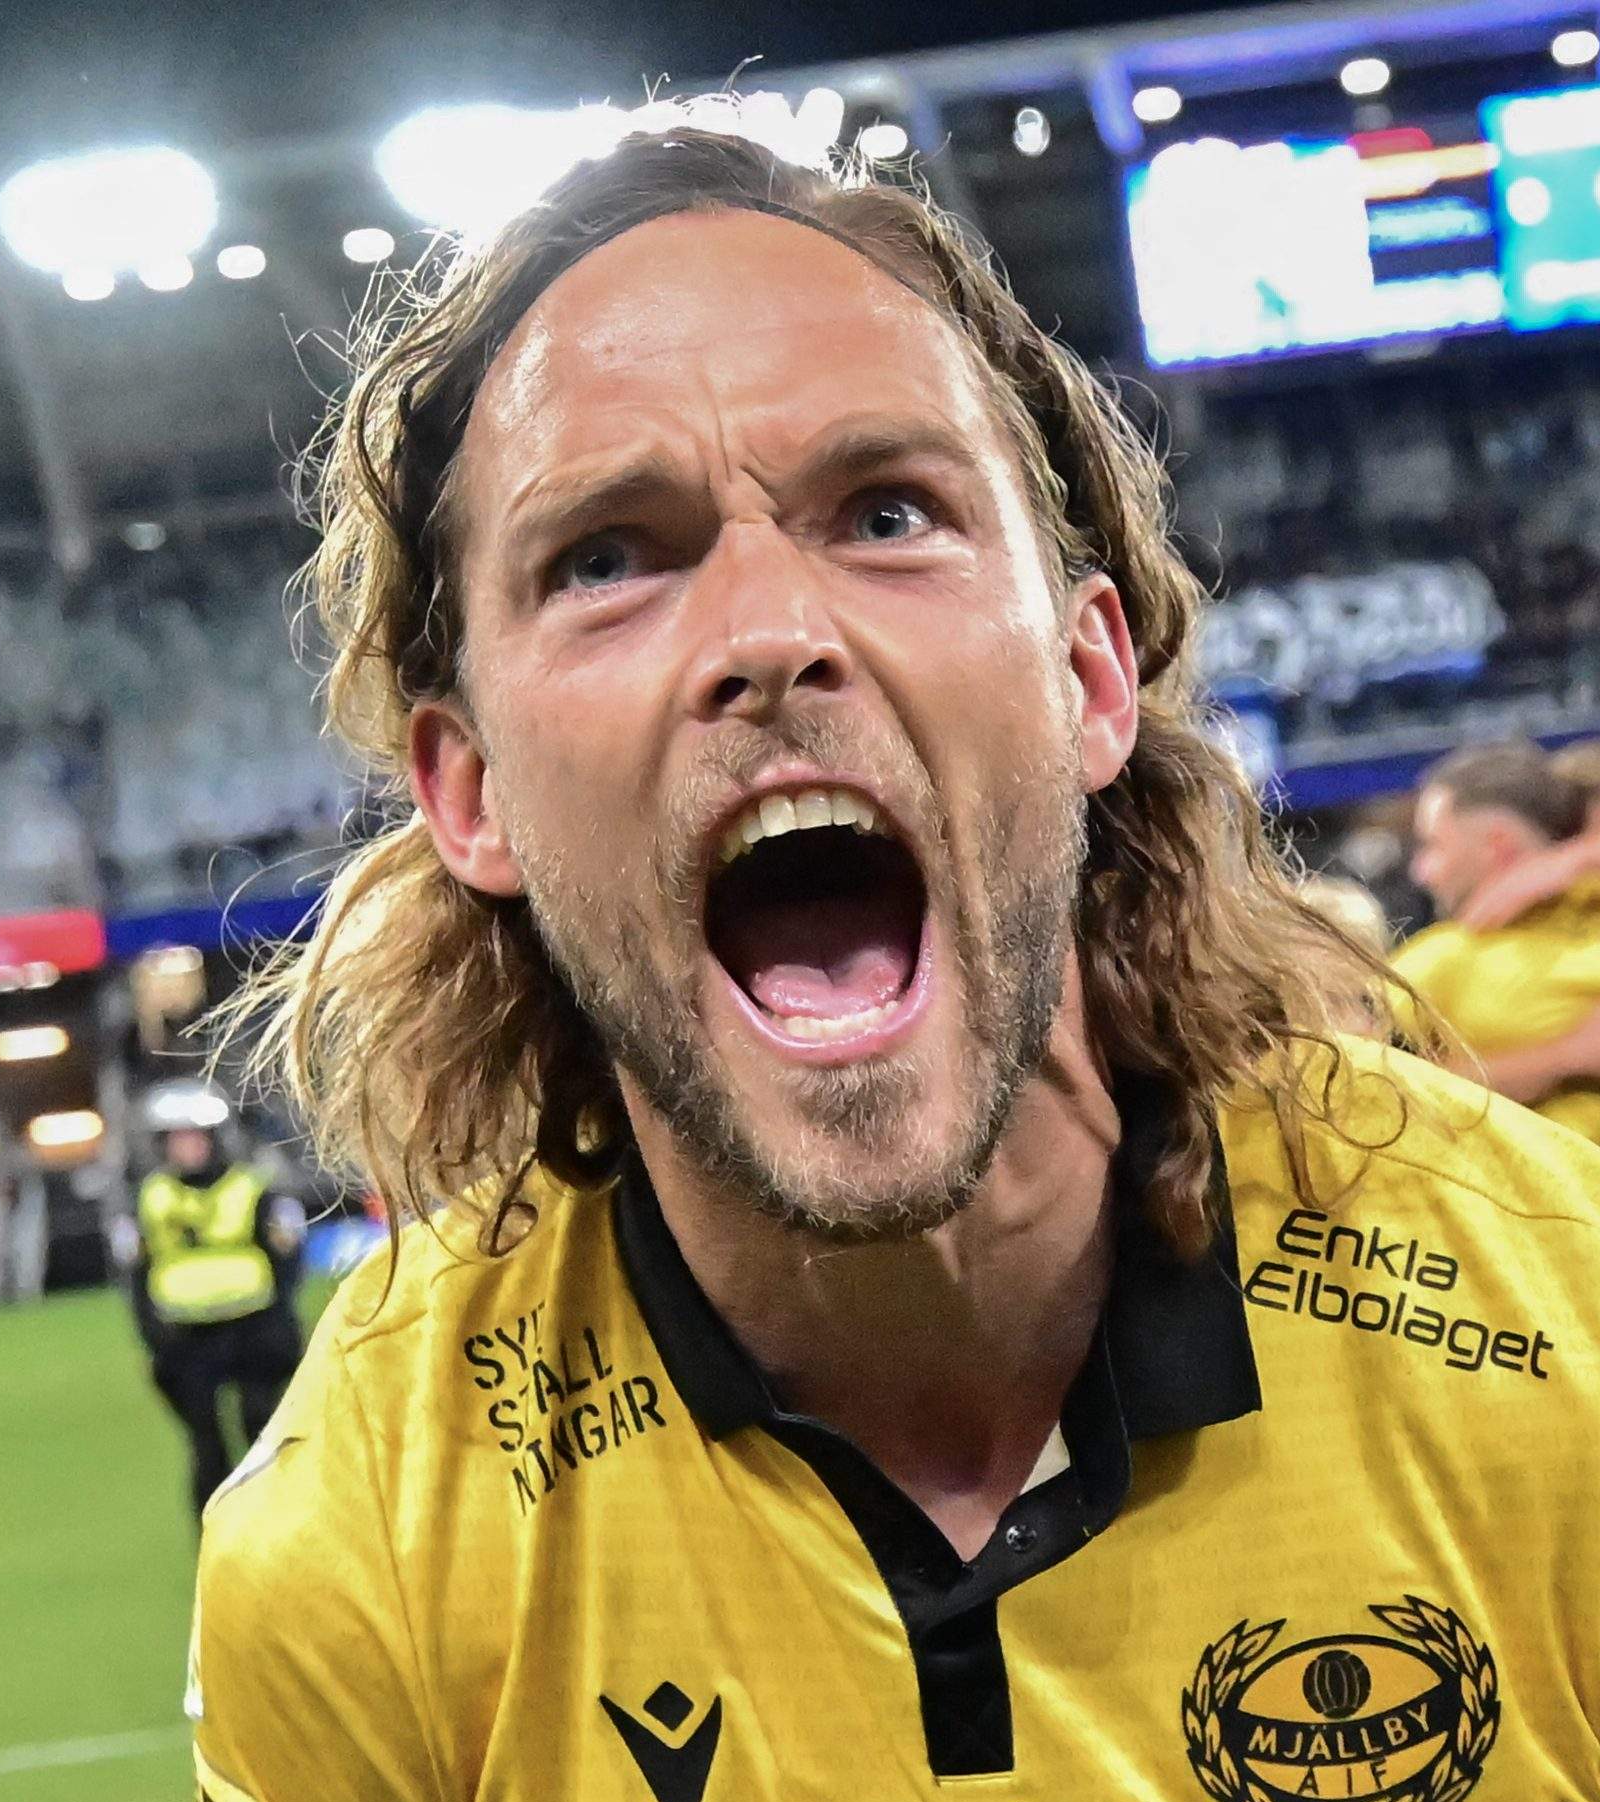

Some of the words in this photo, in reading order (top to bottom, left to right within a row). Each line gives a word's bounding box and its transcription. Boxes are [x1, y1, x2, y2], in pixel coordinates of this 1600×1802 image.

[1275, 1208, 1460, 1292] Enkla
[1243, 1260, 1556, 1380] Elbolaget
[511, 1375, 667, 1517] NINGAR
[1247, 1702, 1432, 1763] MJÄLLBY
